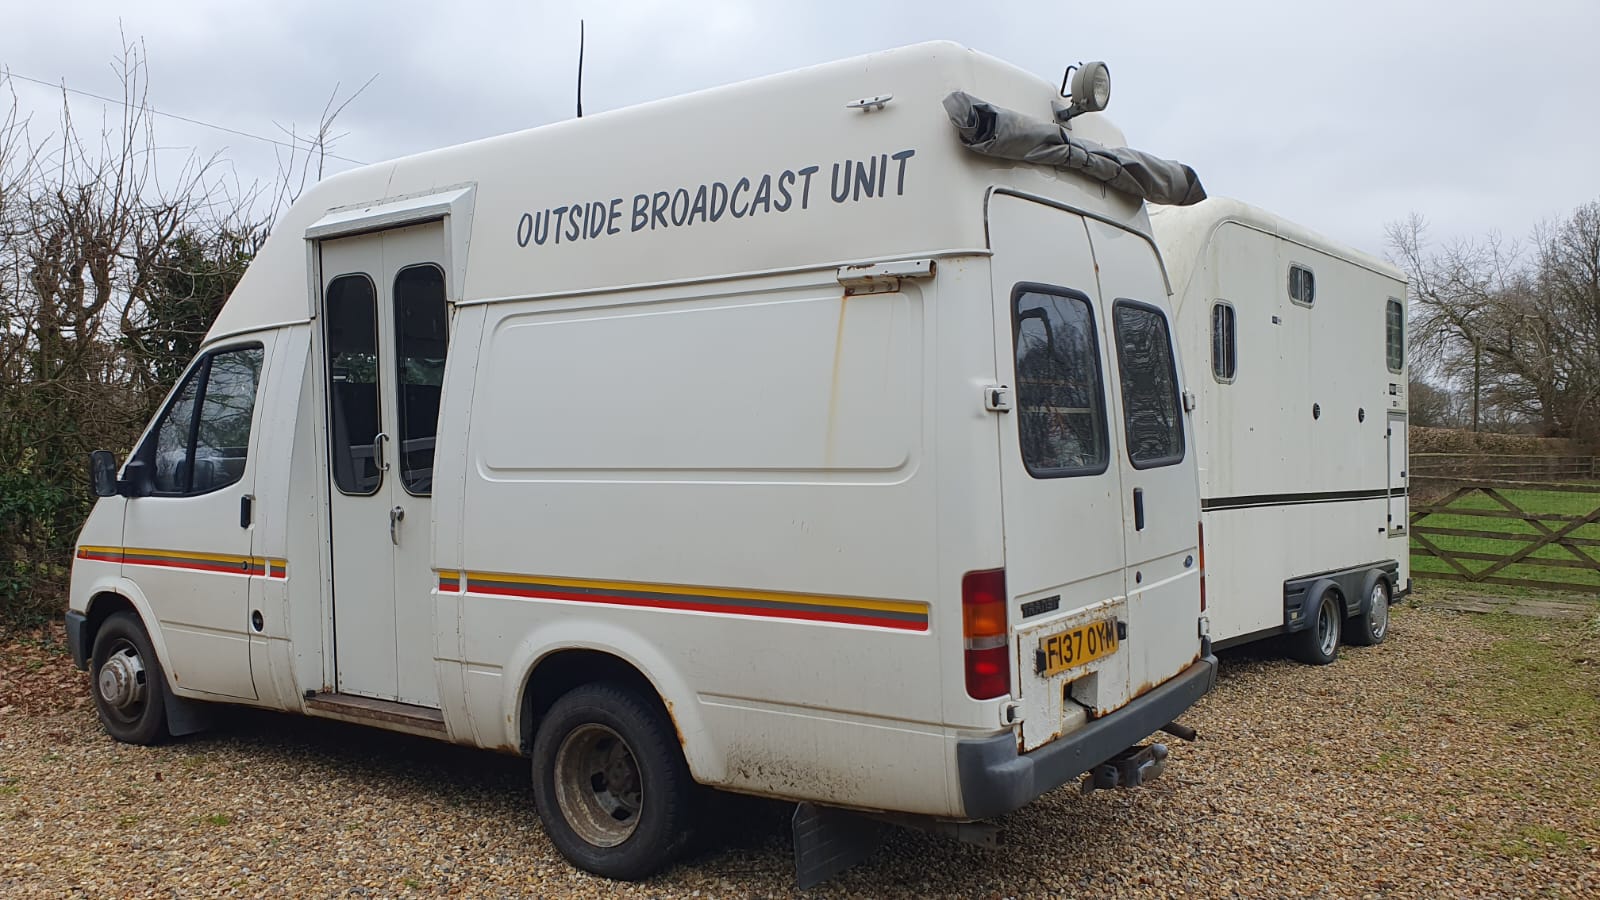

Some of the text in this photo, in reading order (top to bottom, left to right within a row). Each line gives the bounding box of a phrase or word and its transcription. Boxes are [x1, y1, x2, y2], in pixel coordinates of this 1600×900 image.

[517, 149, 915, 248] OUTSIDE BROADCAST UNIT
[1047, 620, 1115, 669] F137 OYM
